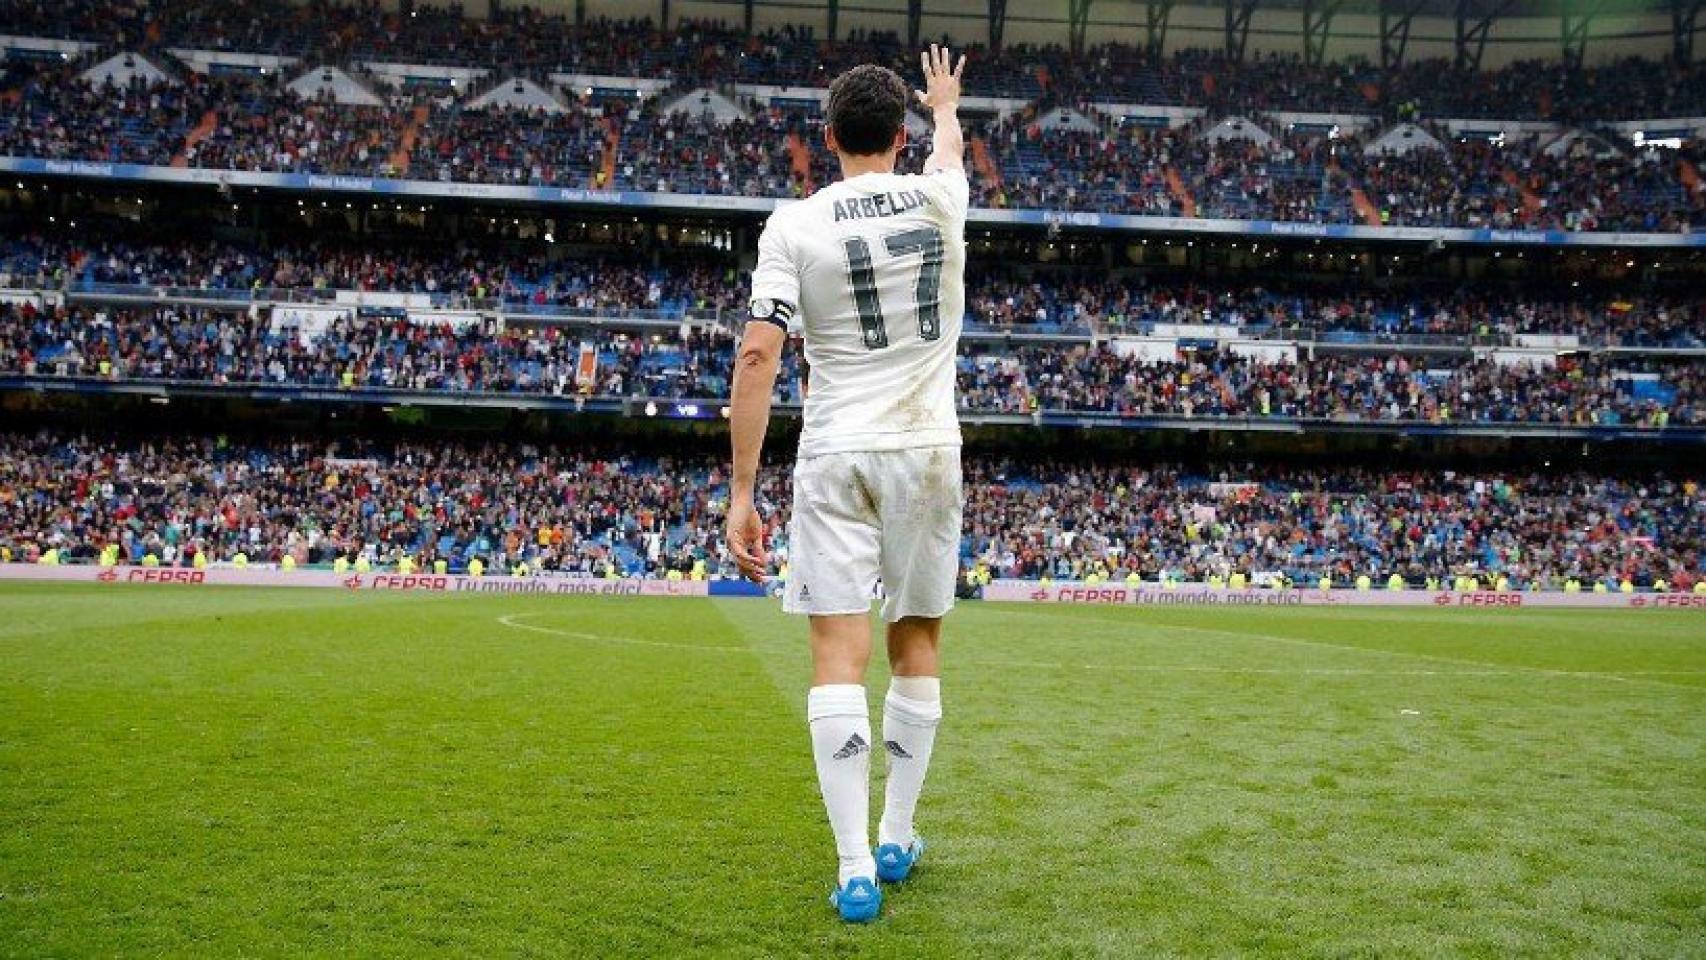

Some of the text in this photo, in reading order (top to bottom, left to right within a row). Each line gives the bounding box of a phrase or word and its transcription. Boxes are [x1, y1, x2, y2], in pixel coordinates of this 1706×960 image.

[833, 189, 932, 221] ARBELOA
[844, 227, 944, 350] 17
[129, 569, 205, 584] CEPSA
[372, 575, 448, 591] CEPSA
[1058, 589, 1127, 604] CEPSA
